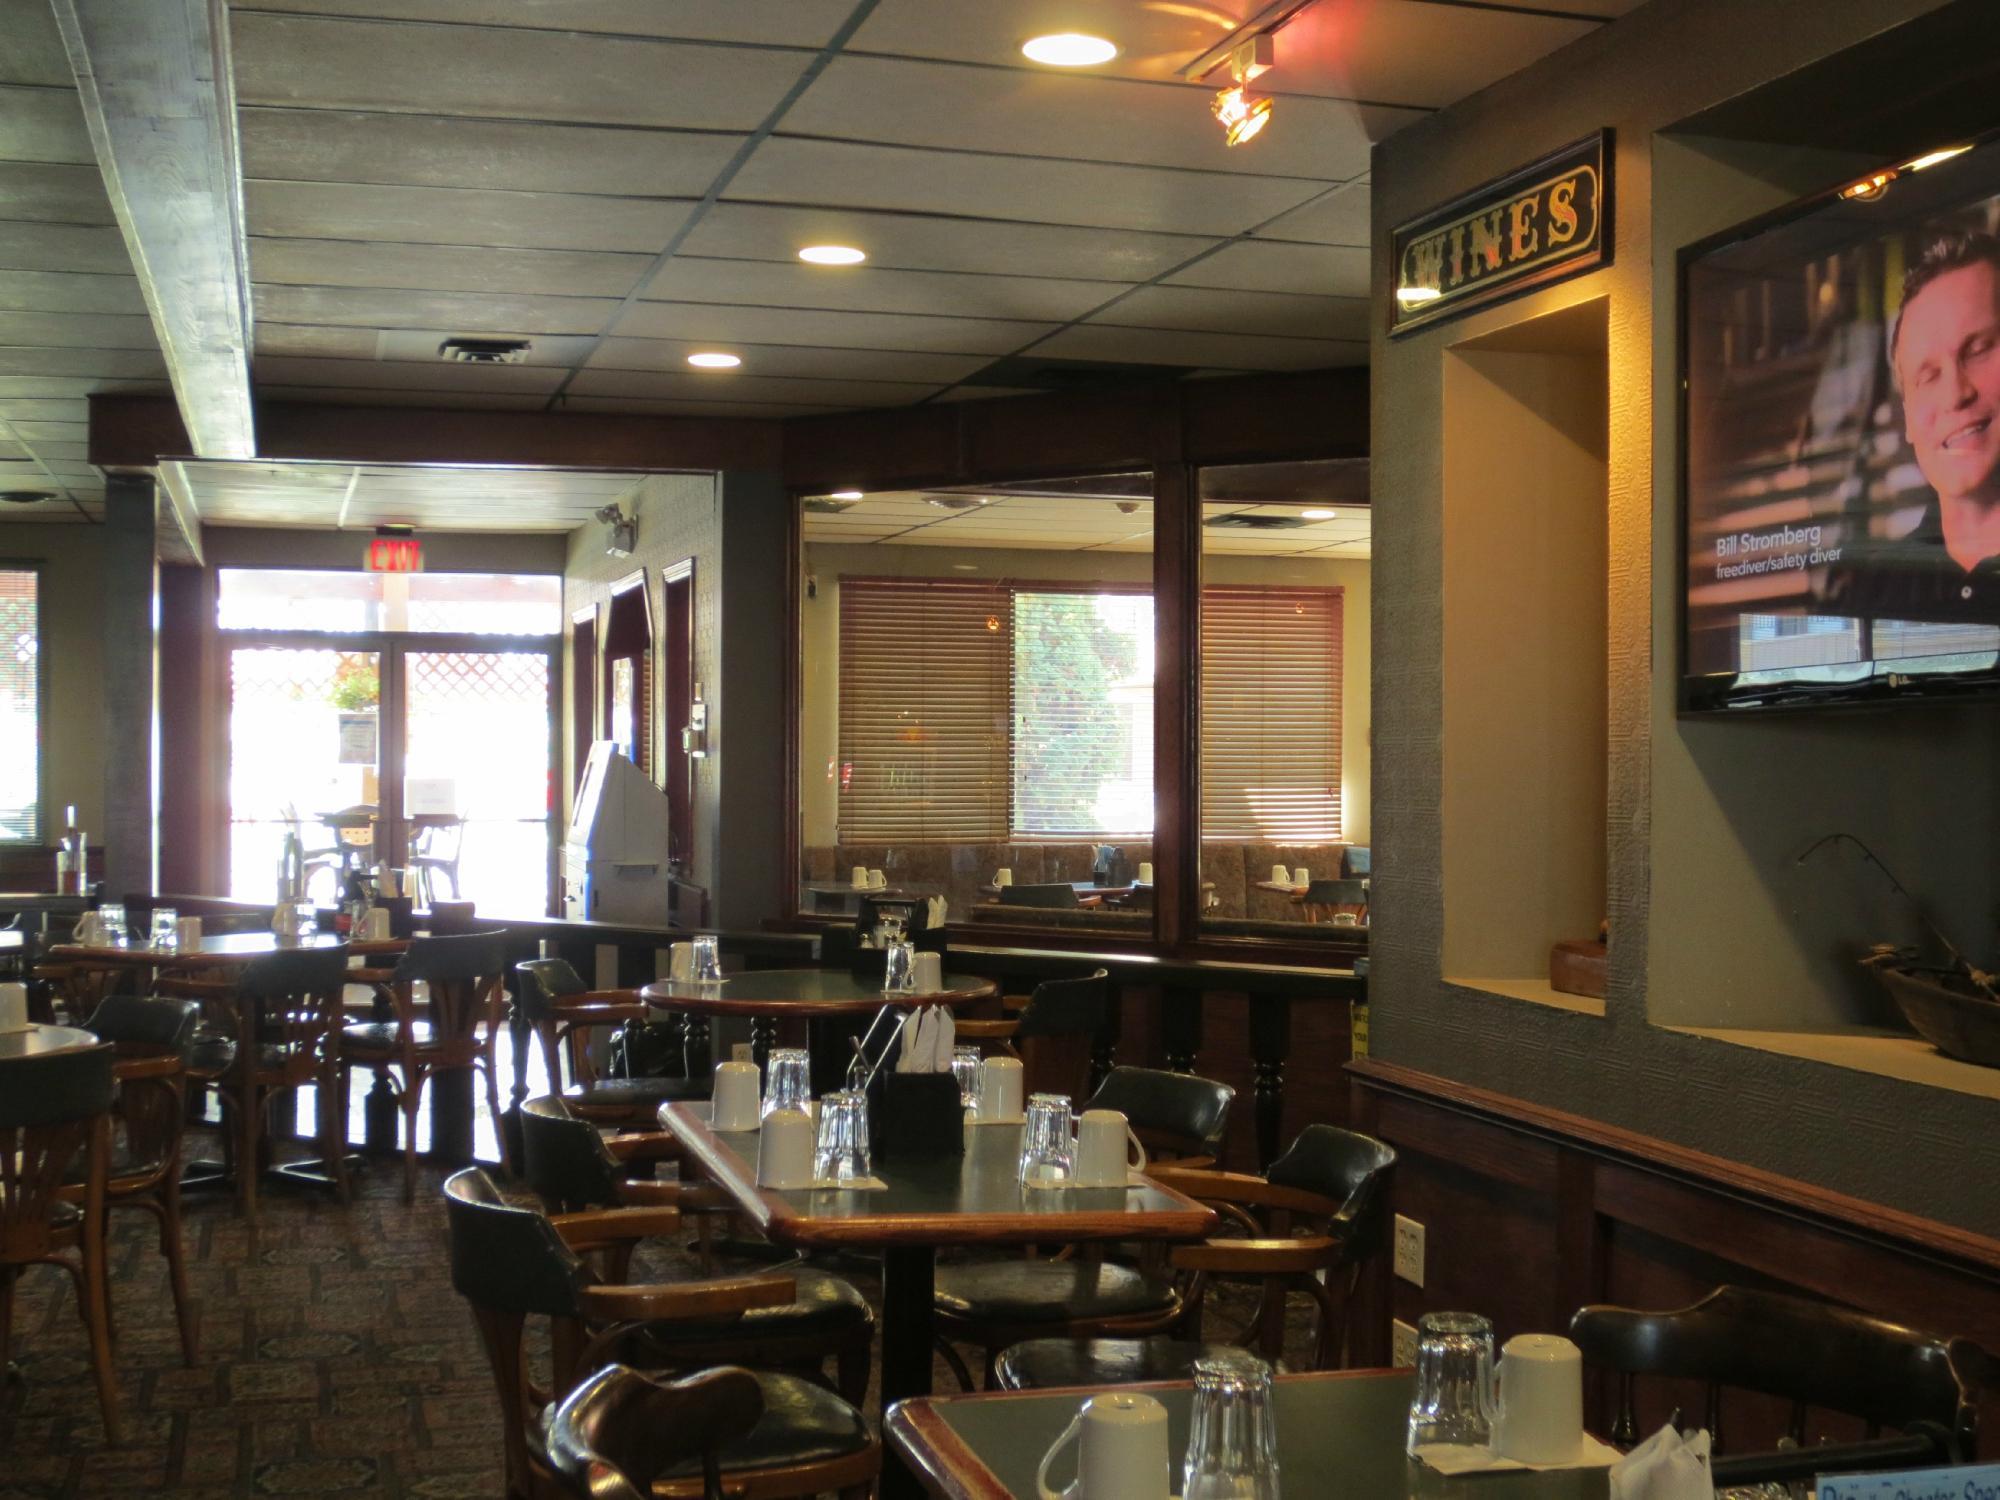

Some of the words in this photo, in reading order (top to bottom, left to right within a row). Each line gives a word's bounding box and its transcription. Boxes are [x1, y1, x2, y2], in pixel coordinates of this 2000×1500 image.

[1412, 179, 1578, 291] WINES
[370, 539, 420, 572] EXIT
[1716, 535, 1737, 557] Bill
[1740, 525, 1822, 553] Stromberg
[1716, 553, 1807, 579] freediver/safety
[1809, 547, 1842, 564] diver
